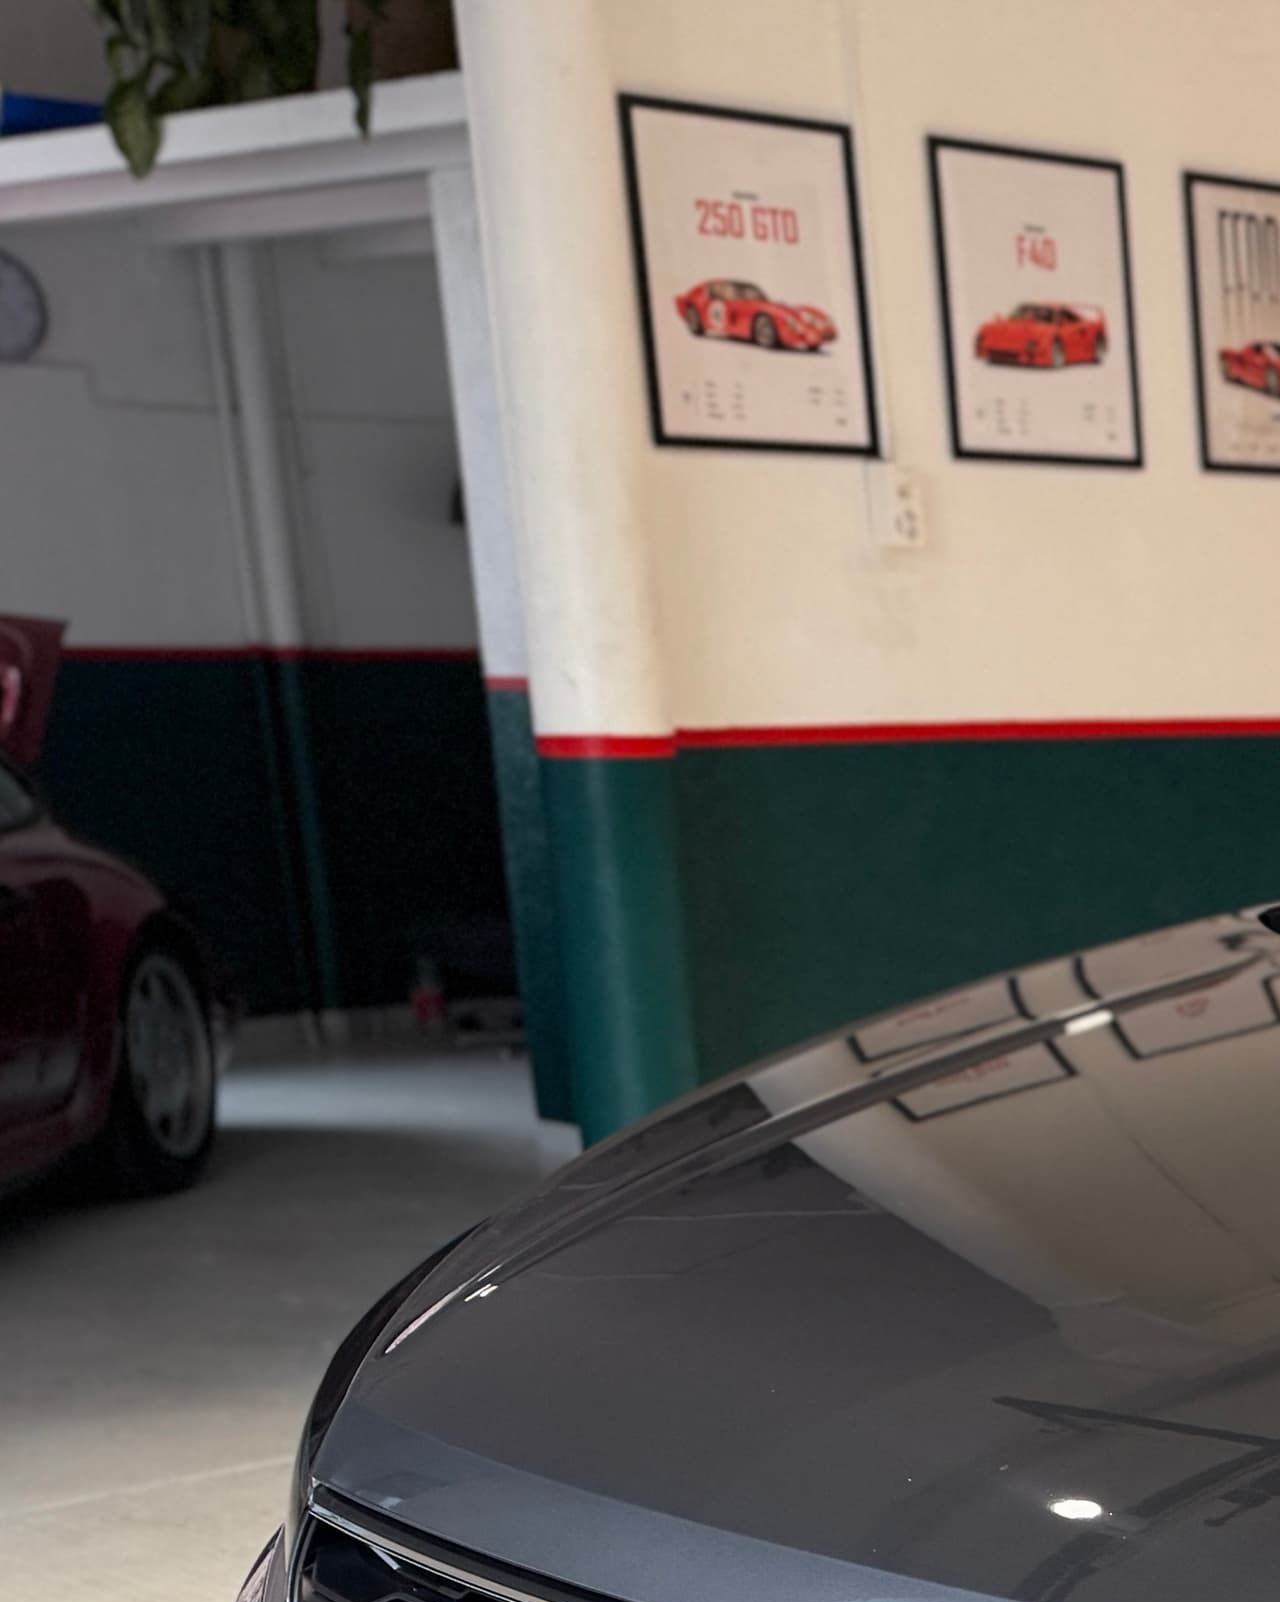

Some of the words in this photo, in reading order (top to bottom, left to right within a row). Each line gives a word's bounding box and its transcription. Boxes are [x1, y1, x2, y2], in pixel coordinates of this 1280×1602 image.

[694, 197, 745, 240] 250
[751, 205, 800, 247] GTO
[1016, 233, 1058, 273] F40
